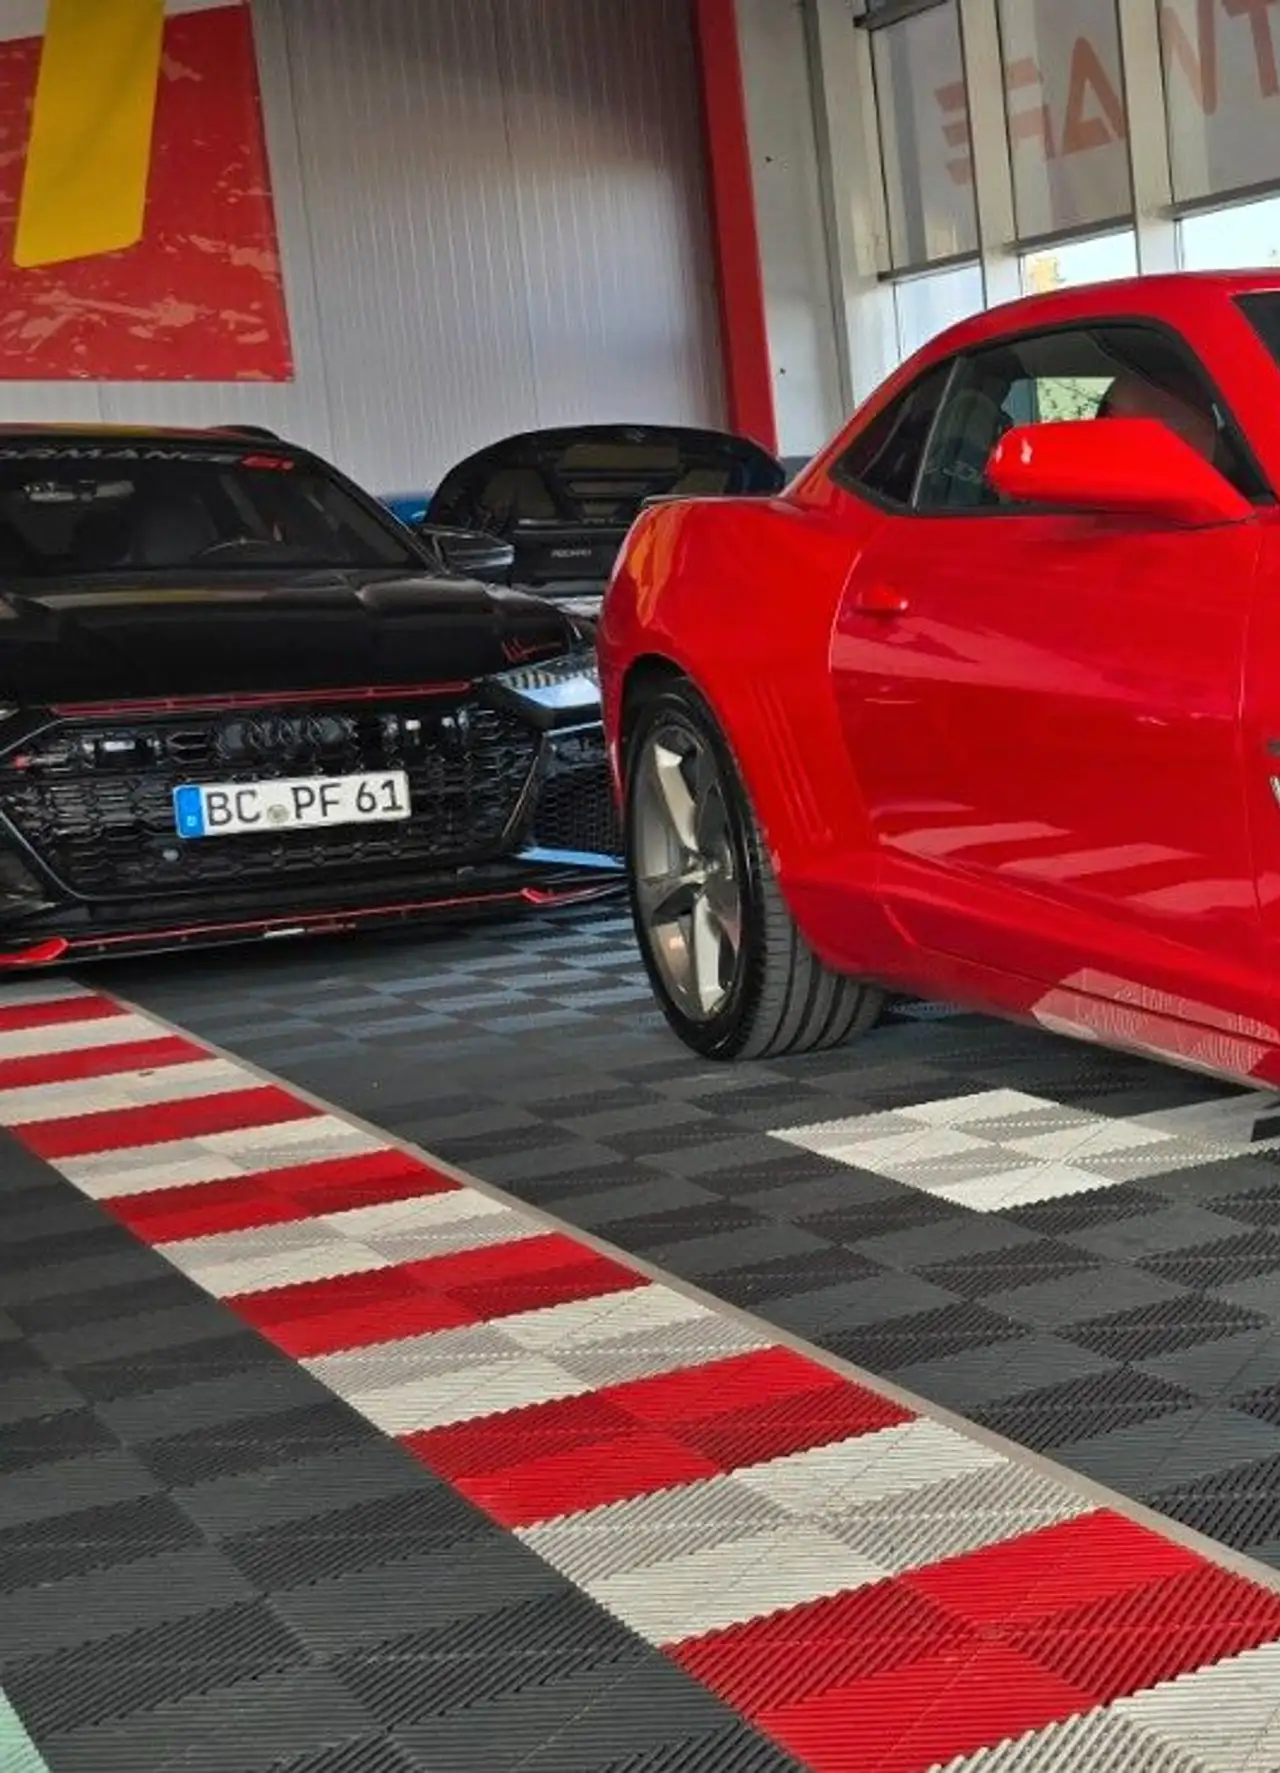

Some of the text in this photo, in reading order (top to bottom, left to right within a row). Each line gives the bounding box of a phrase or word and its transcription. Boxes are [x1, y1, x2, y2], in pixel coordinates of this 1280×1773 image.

[205, 779, 404, 827] BC PF 61
